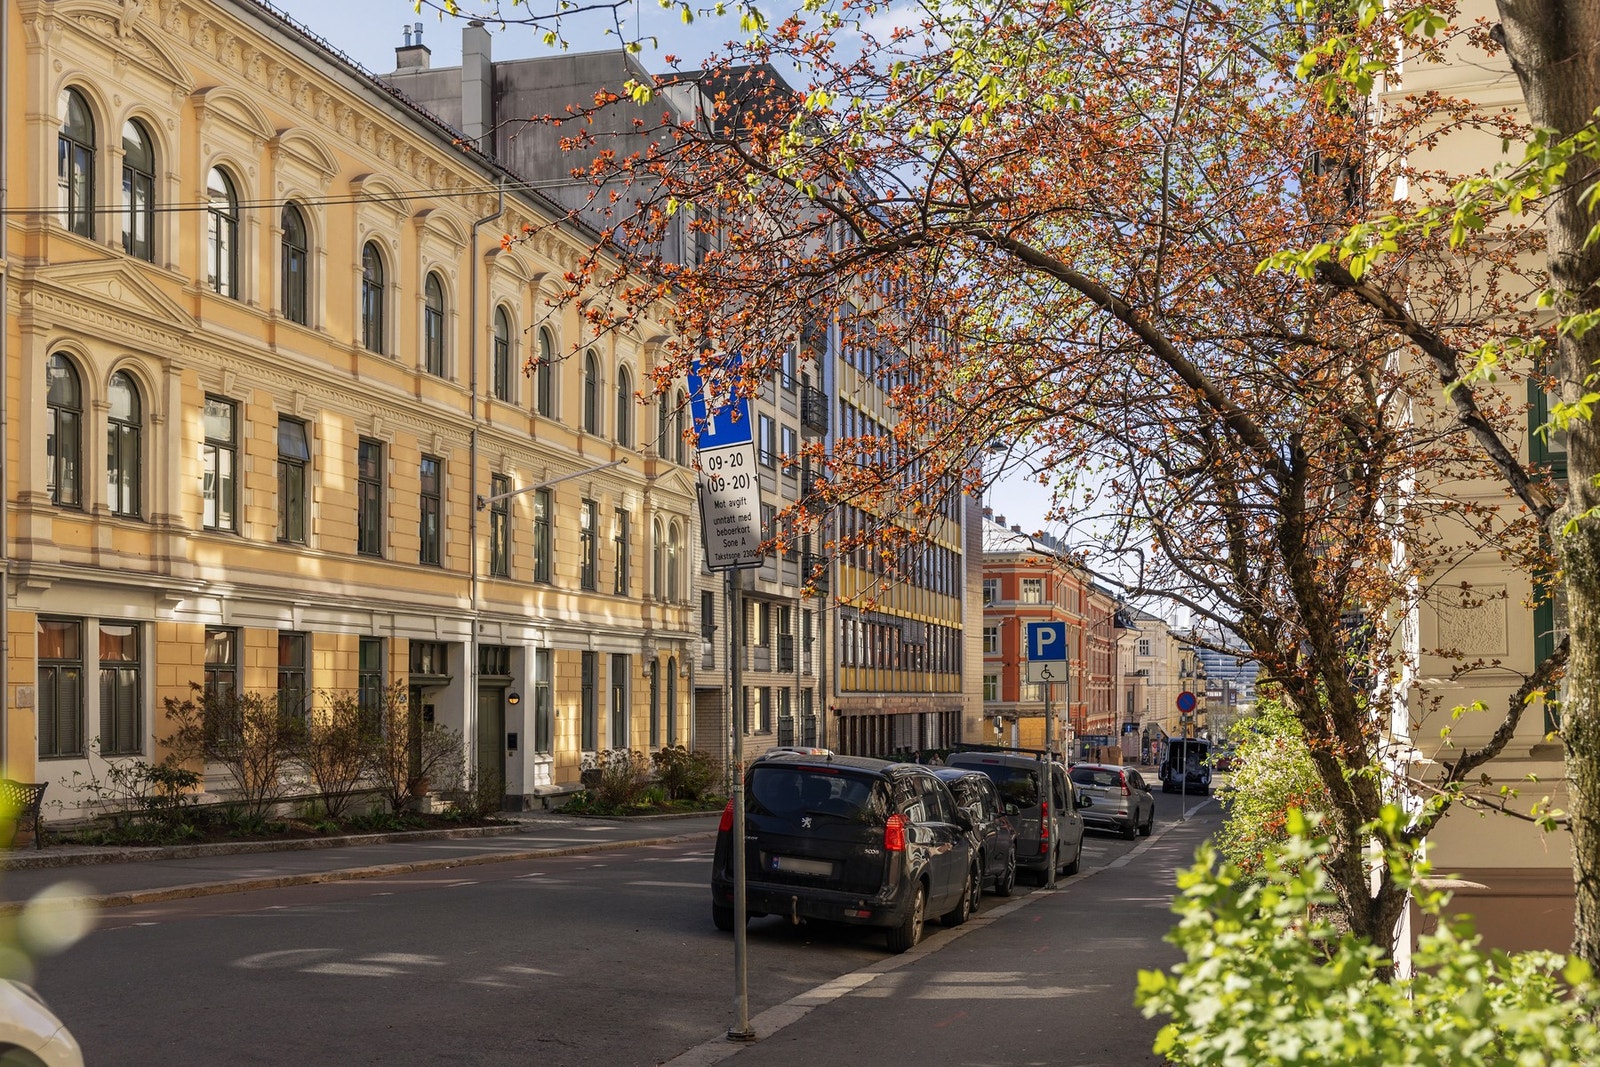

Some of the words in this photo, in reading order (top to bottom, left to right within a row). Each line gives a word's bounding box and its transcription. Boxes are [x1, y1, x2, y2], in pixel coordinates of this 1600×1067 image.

[708, 452, 744, 470] 09-20
[707, 472, 750, 495] (09-20)
[714, 500, 726, 508] Mot
[728, 497, 747, 508] avgift
[714, 516, 736, 525] unntatt
[738, 512, 752, 522] med
[716, 526, 751, 536] beboerkort
[722, 538, 738, 548] Sone
[741, 537, 746, 546] A
[714, 552, 740, 560] Takstsone
[1036, 627, 1056, 656] P
